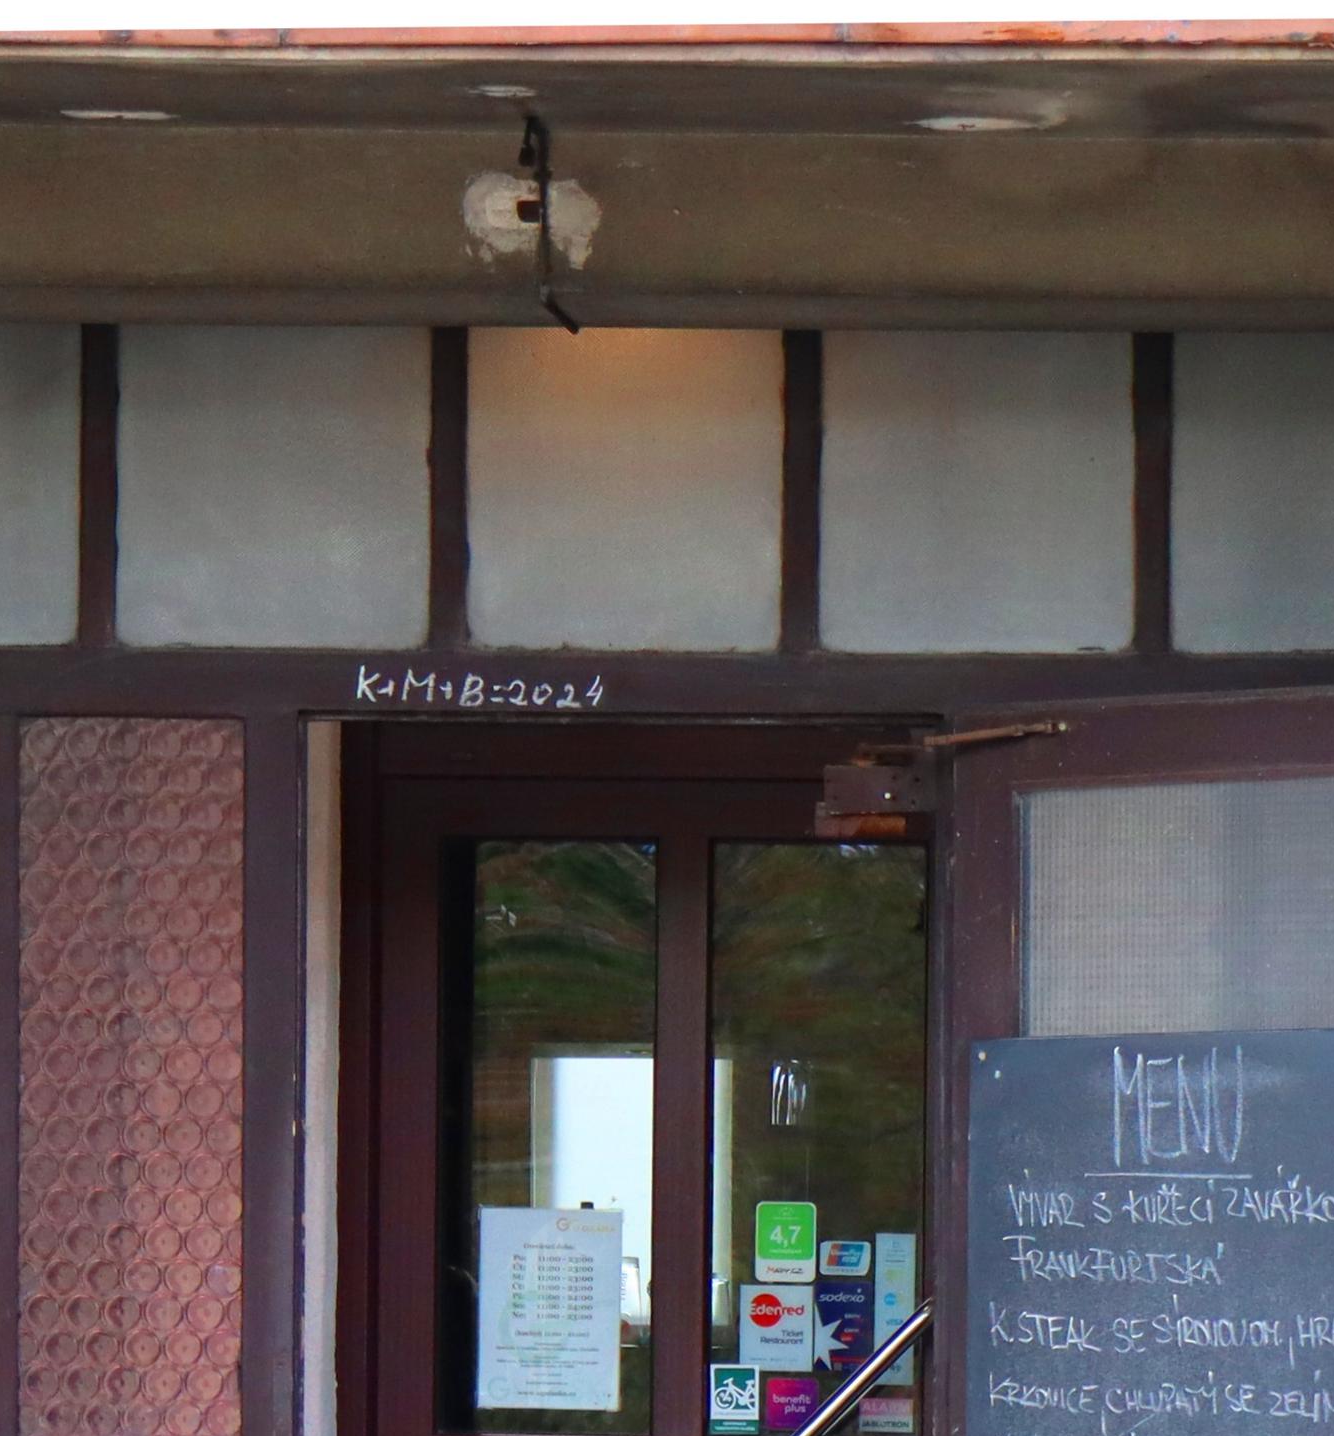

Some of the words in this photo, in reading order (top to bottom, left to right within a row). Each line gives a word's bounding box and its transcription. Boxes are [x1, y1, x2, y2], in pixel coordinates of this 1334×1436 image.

[1113, 1045, 1244, 1167] MENU
[769, 1225, 802, 1249] 4,7
[750, 1303, 805, 1316] Edenred
[781, 1329, 804, 1338] Ticket
[1111, 1317, 1149, 1354] SE
[772, 1393, 812, 1404] benefit
[1225, 1384, 1260, 1415] SE
[784, 1403, 806, 1415] plus
